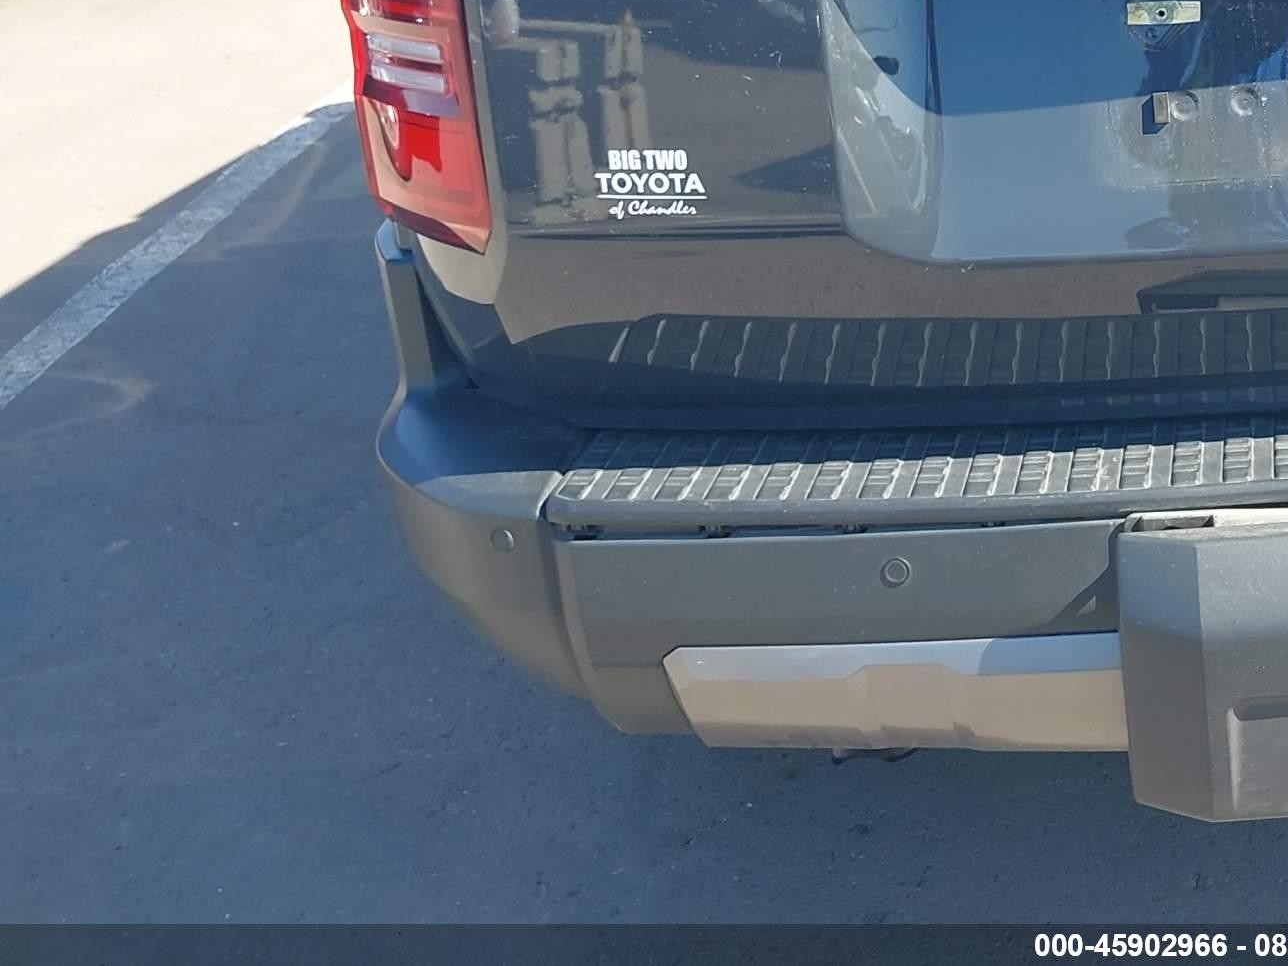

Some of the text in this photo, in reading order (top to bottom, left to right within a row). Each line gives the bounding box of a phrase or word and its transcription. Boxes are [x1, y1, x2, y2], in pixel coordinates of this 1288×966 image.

[607, 149, 688, 171] BIG TWO
[594, 172, 706, 194] TOYOTA
[608, 200, 697, 220] of Chandler
